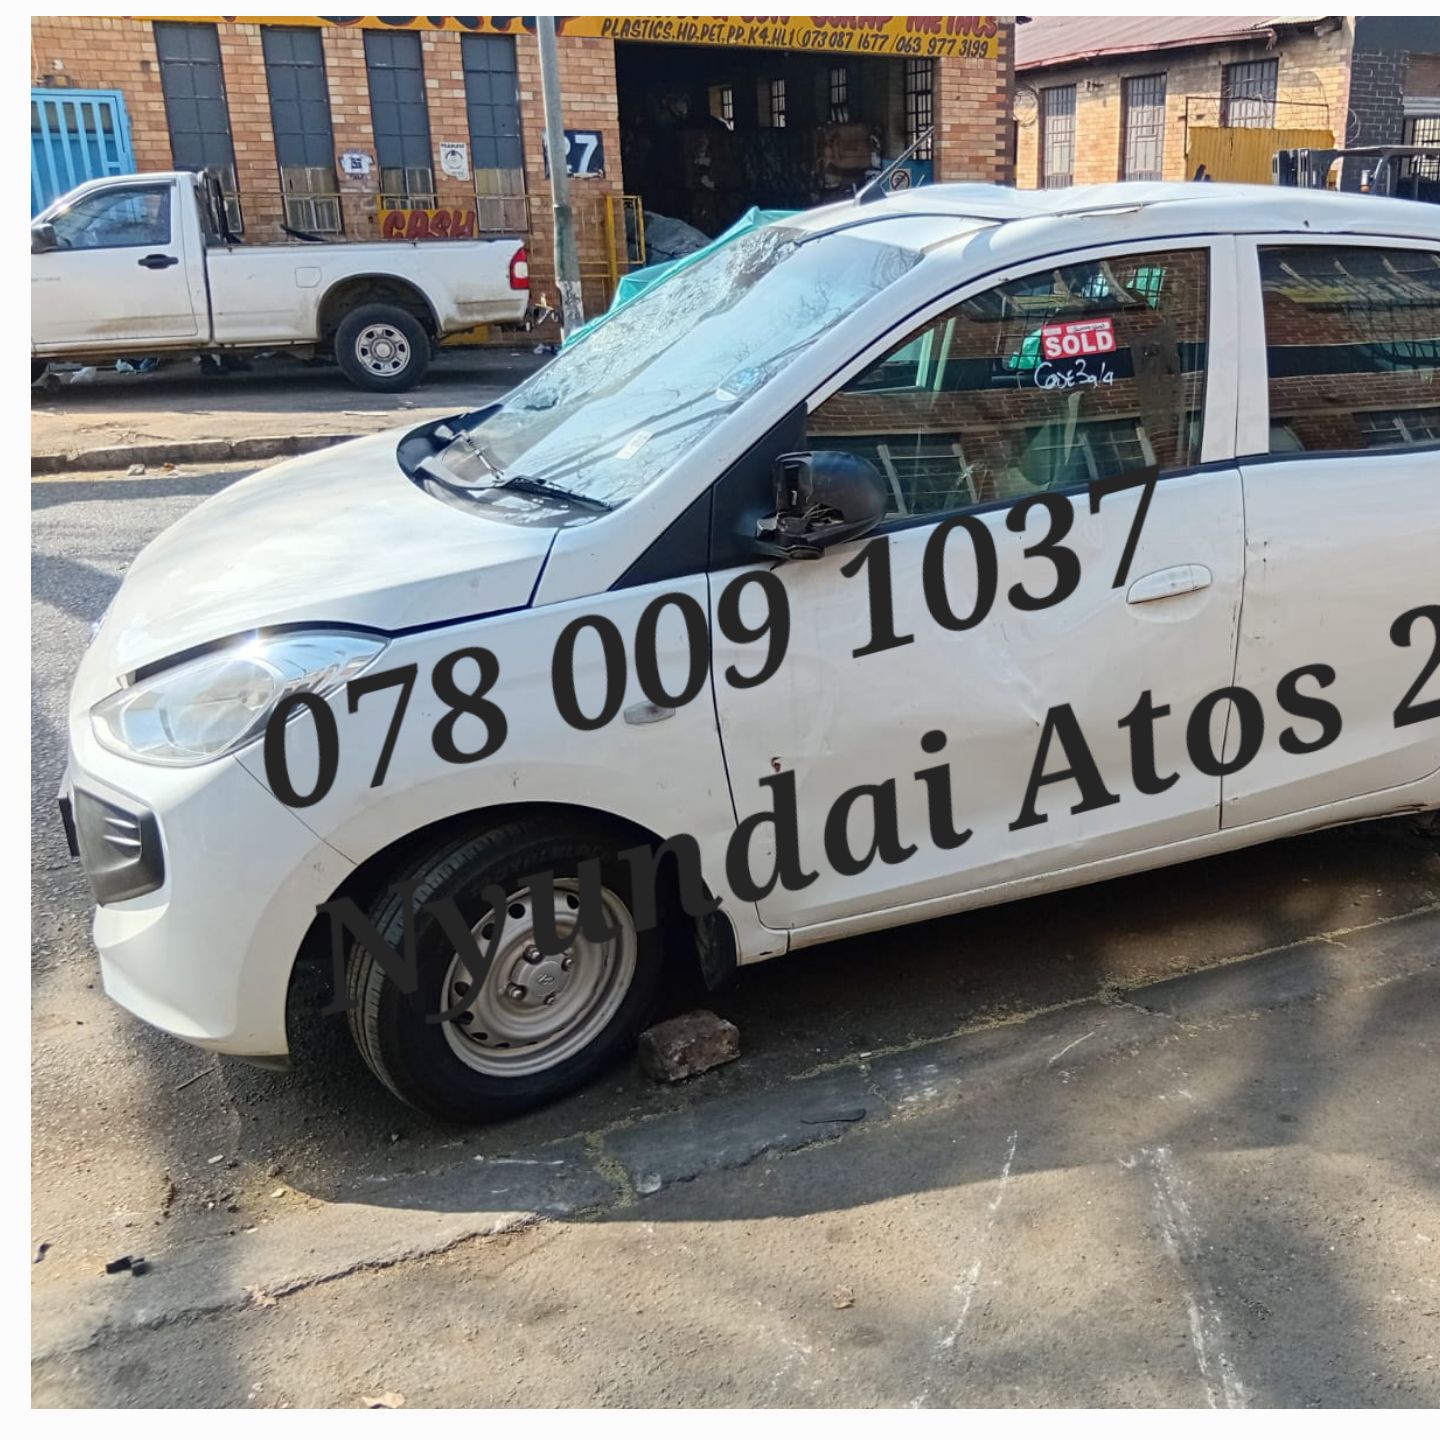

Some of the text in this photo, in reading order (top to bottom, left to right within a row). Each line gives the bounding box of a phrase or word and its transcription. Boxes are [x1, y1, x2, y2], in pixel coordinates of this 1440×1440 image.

[907, 16, 998, 39] METALS
[383, 210, 476, 239] CASH
[1045, 330, 1114, 358] SOLD
